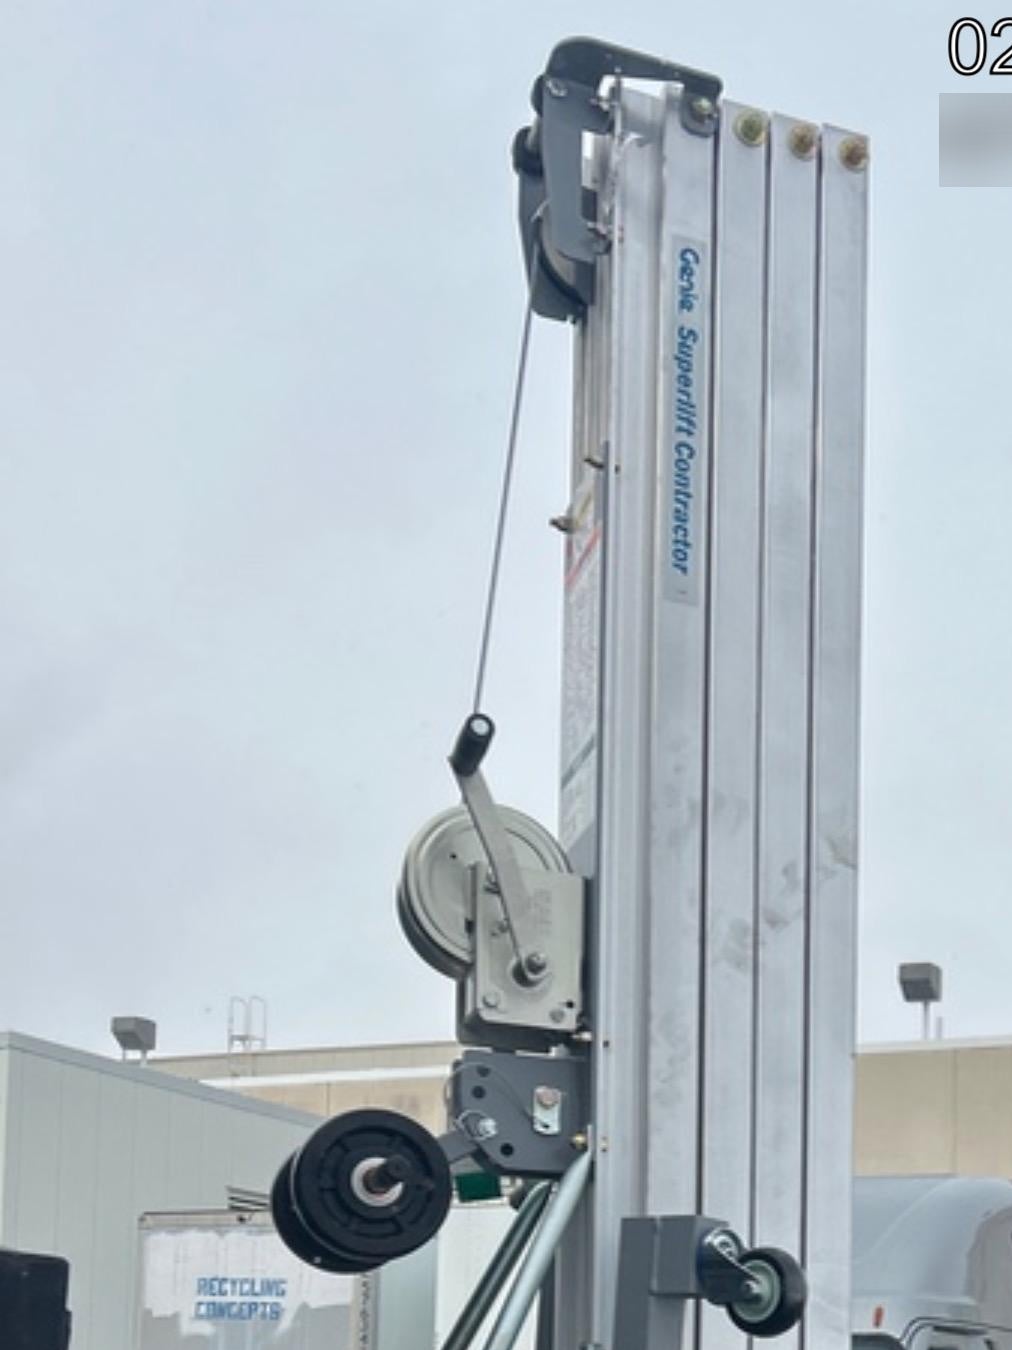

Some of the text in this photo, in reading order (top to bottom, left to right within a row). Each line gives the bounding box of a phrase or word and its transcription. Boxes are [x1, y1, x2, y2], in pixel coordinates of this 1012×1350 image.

[672, 248, 700, 576] Genie Superlift Contractor
